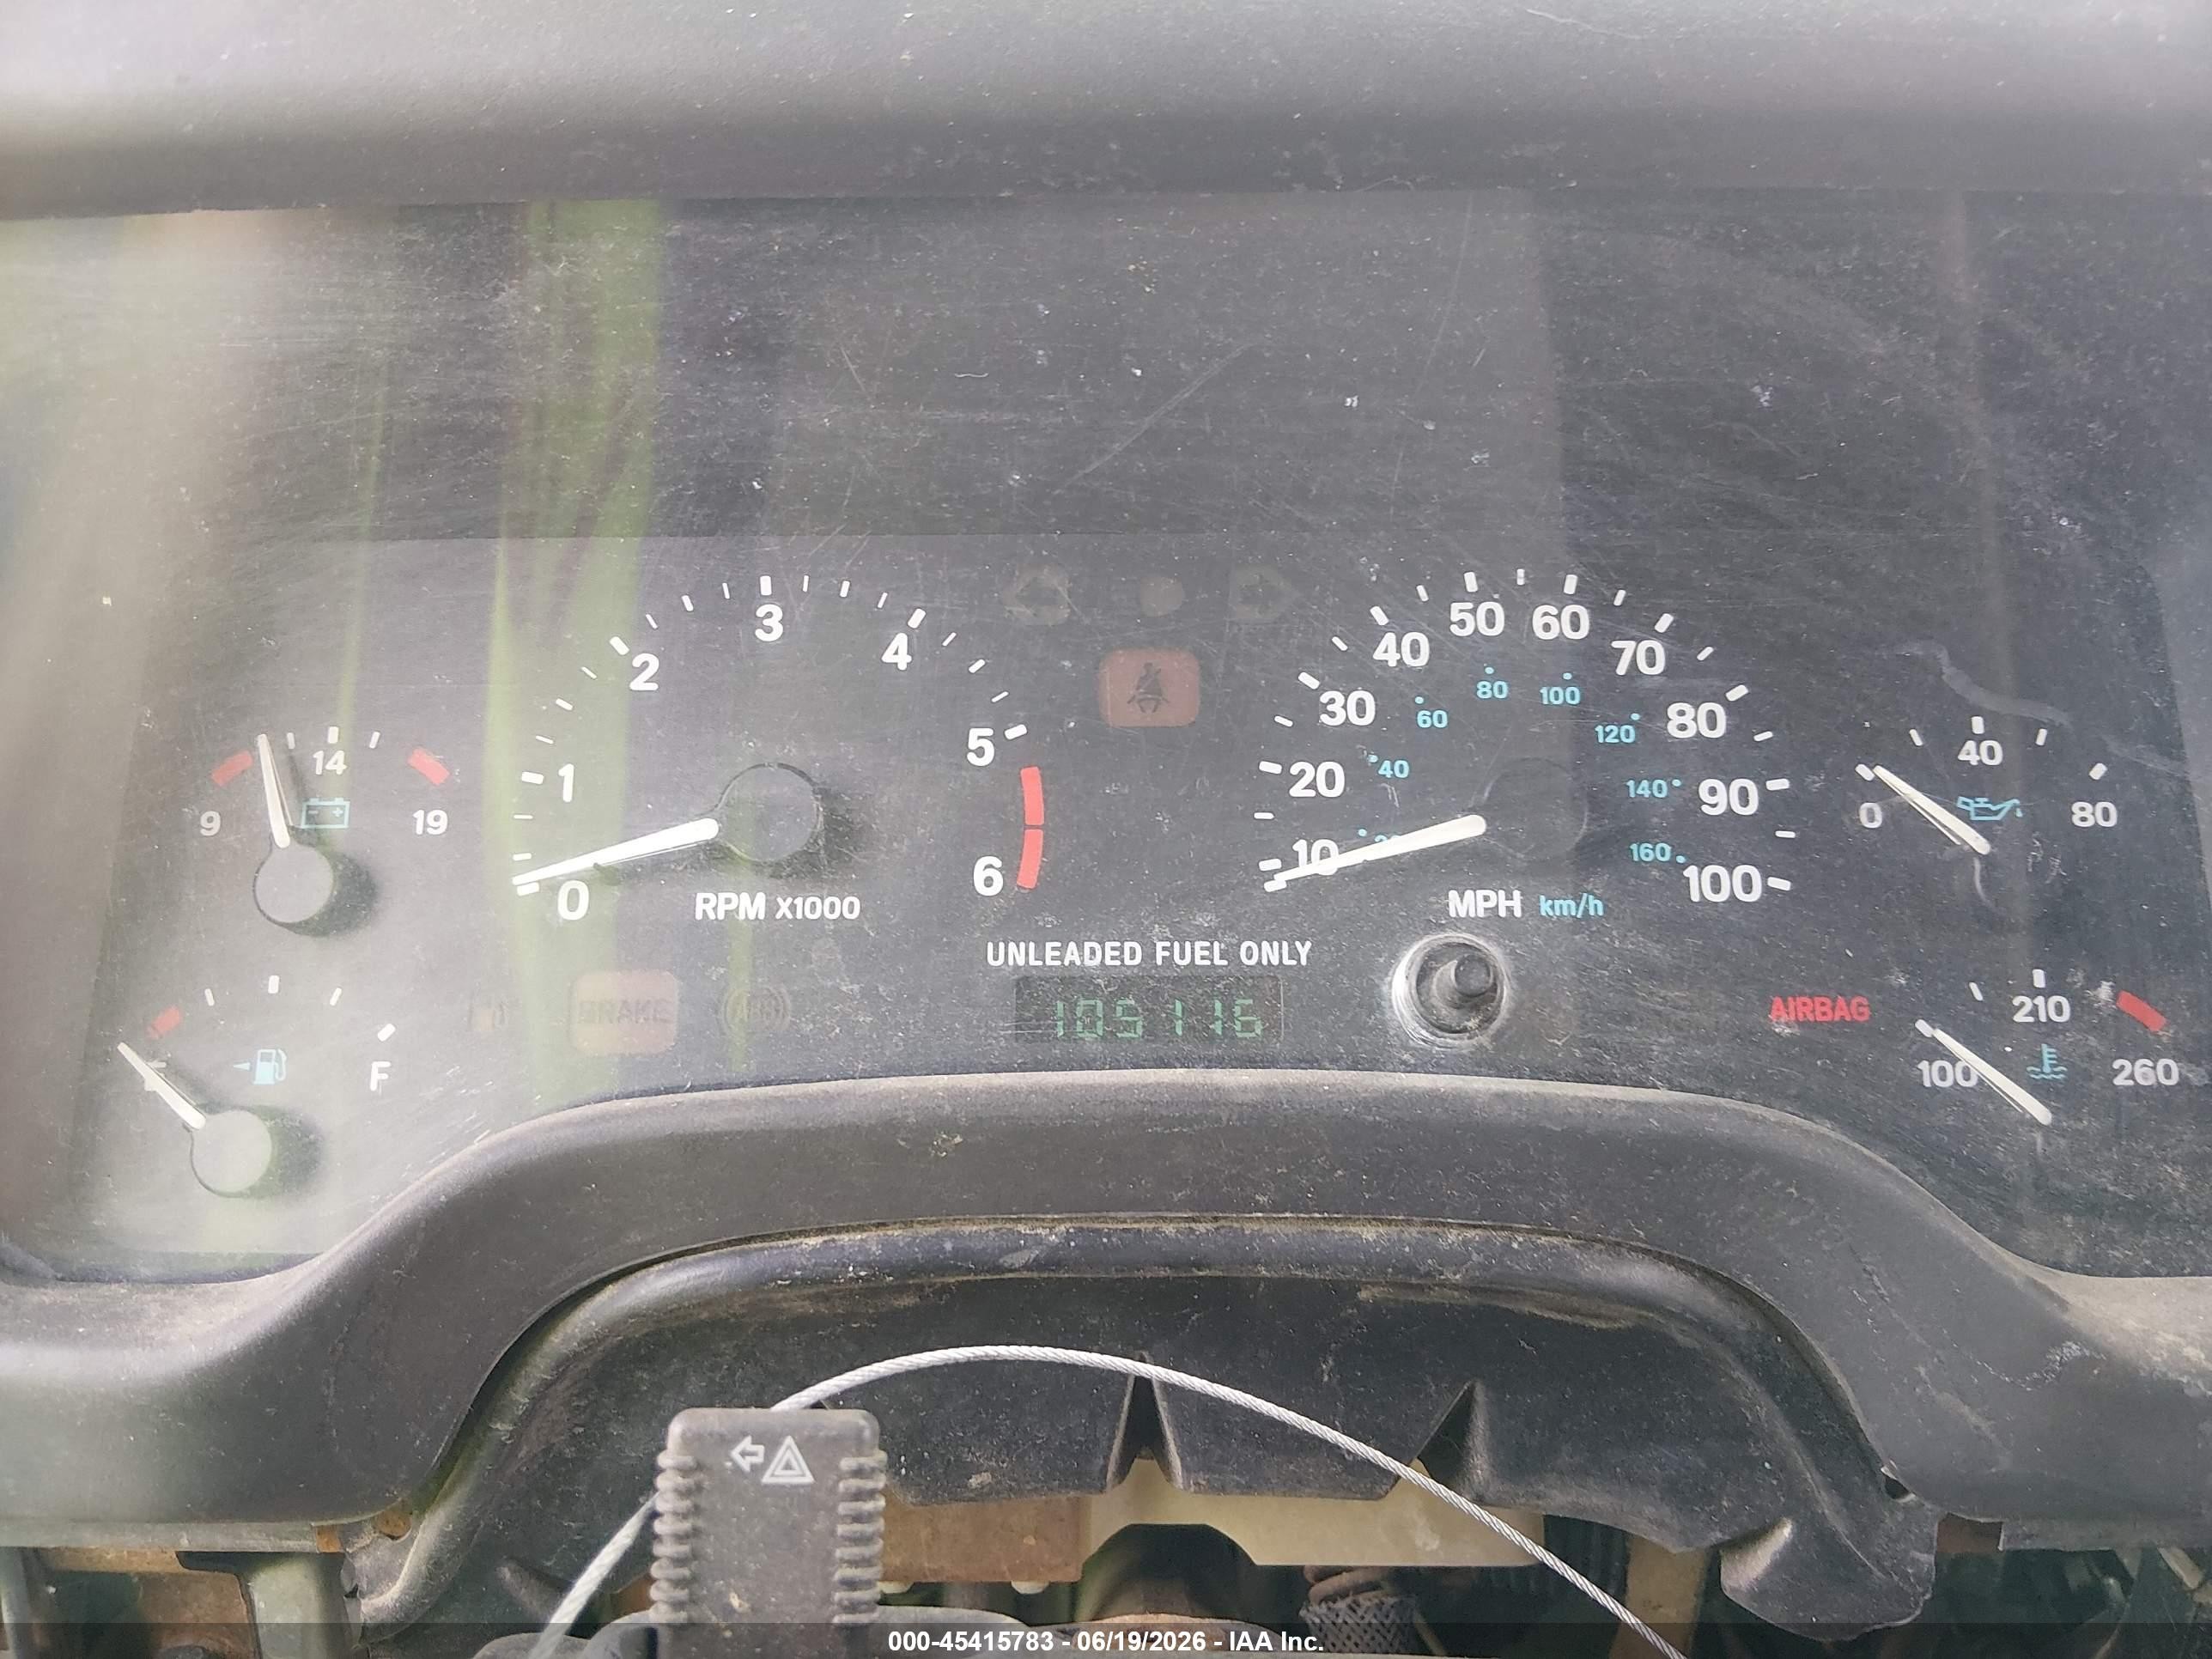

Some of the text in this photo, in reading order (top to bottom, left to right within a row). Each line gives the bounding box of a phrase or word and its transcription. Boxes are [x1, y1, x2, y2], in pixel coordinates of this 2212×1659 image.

[756, 605, 783, 641] 3
[1450, 602, 1504, 636] 50
[1533, 605, 1589, 640] 60
[882, 633, 911, 670] 4
[1373, 632, 1429, 666] 40
[1612, 641, 1665, 675] 70
[629, 653, 659, 690] 2
[1477, 681, 1508, 699] 80
[1540, 686, 1581, 706] 100
[1320, 690, 1375, 726] 30
[1416, 710, 1447, 729] 60
[1668, 702, 1726, 738] 80
[967, 728, 994, 766] 5
[1597, 725, 1636, 744] 120
[313, 750, 346, 775] 14
[1958, 740, 2002, 765] 40
[559, 764, 574, 802] 1
[1290, 762, 1345, 797] 20
[1379, 760, 1408, 778] 40
[1628, 779, 1668, 799] 140
[1698, 779, 1759, 815] 90
[200, 811, 220, 836] 9
[413, 810, 447, 835] 19
[1860, 803, 1882, 828] 0
[2072, 802, 2117, 827] 80
[1292, 839, 1339, 876] 10
[1630, 843, 1671, 862] 160
[974, 856, 1003, 896] 6
[1683, 865, 1762, 902] 100
[558, 880, 588, 920] 0
[696, 892, 765, 920] RPM
[1446, 890, 1606, 917] MPH km/h
[988, 940, 1311, 966] UNLEADED FUEL ONLY
[578, 1000, 673, 1024] BRAKE
[1056, 998, 1261, 1039] 105116
[1771, 996, 1870, 1022] AIRBAG
[2013, 996, 2070, 1022] 210
[370, 1061, 390, 1091] F
[1917, 1060, 1977, 1088] 100
[2112, 1059, 2179, 1085] 260
